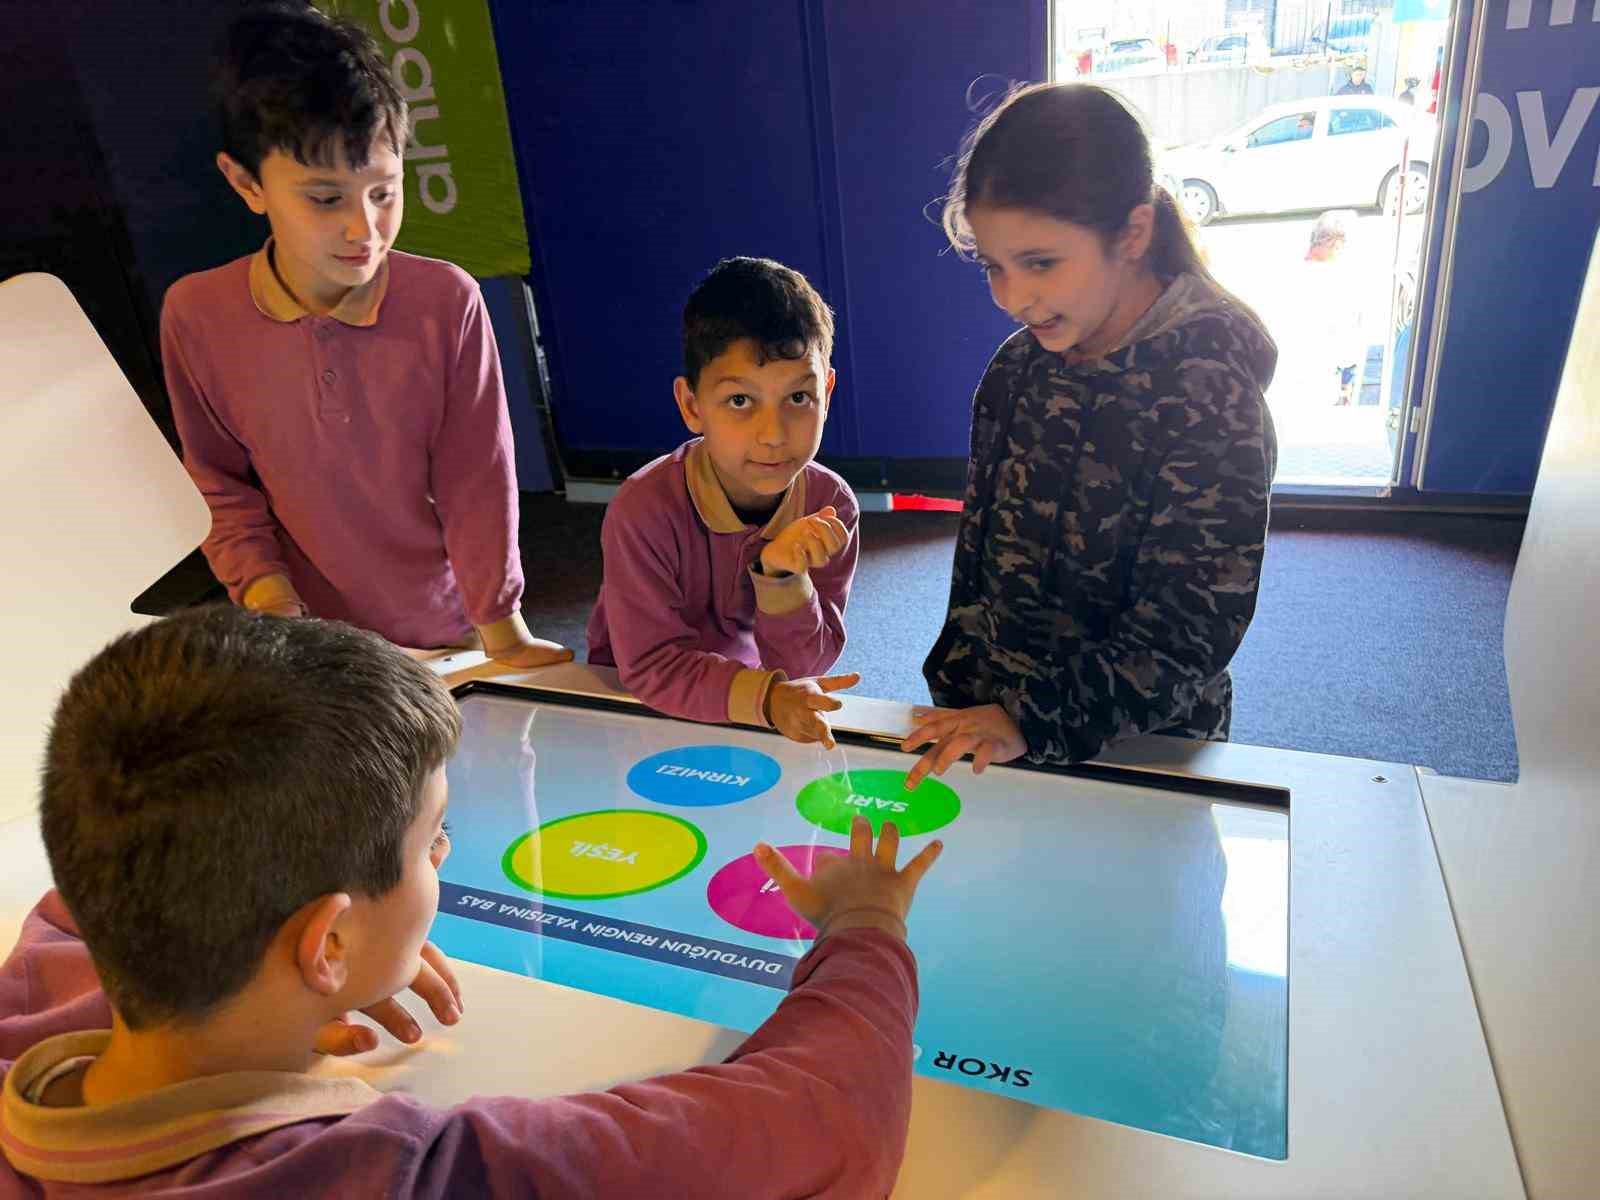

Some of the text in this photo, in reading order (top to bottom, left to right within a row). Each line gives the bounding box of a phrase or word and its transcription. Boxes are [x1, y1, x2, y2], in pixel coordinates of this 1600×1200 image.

[655, 764, 751, 787] KIRMIZI
[845, 793, 909, 813] SARI
[457, 894, 783, 975] DUYDUĞUN RENGİN YAZISINA BAS
[932, 1050, 1033, 1087] SKOR
